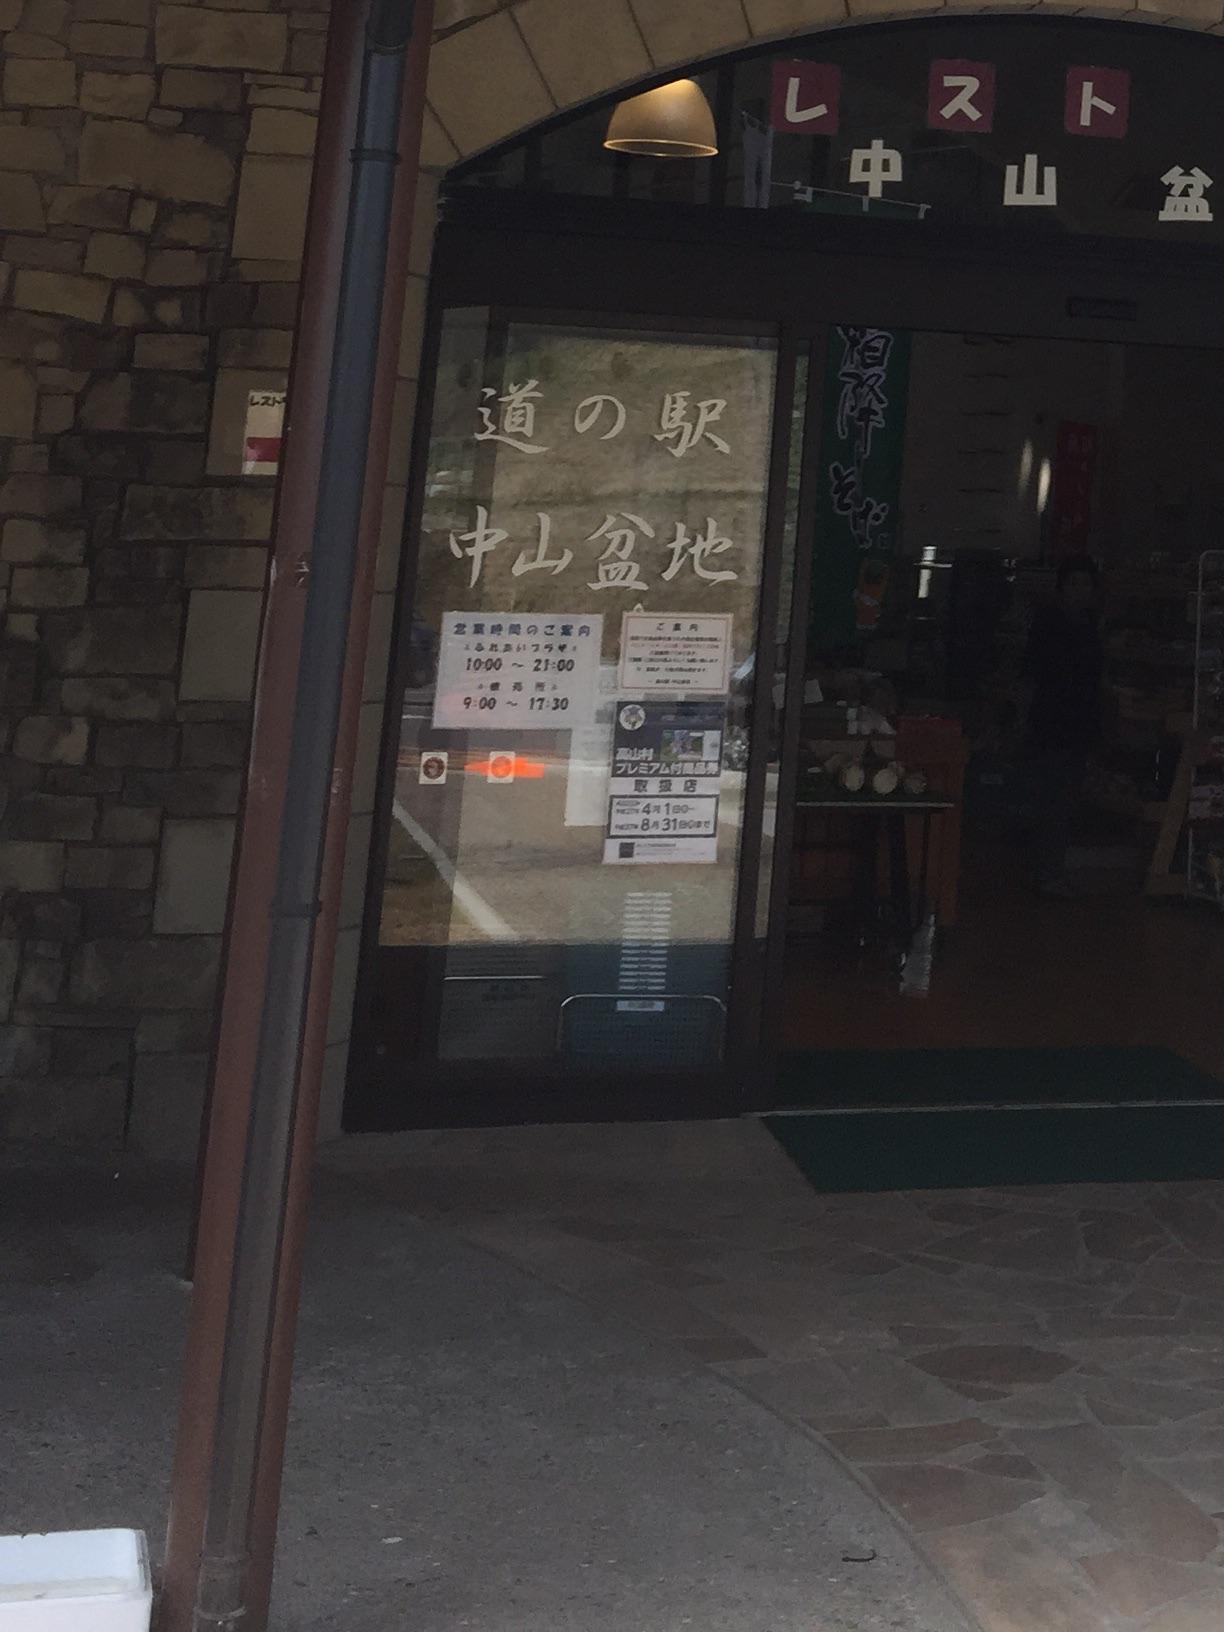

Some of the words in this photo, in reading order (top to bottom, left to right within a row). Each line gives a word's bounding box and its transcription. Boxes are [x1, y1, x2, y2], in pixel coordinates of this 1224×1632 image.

[474, 379, 731, 457] 道の駅
[450, 505, 738, 590] 中山盆地
[466, 657, 503, 672] 10:00
[533, 658, 575, 672] 21:00
[463, 696, 497, 710] 9:00
